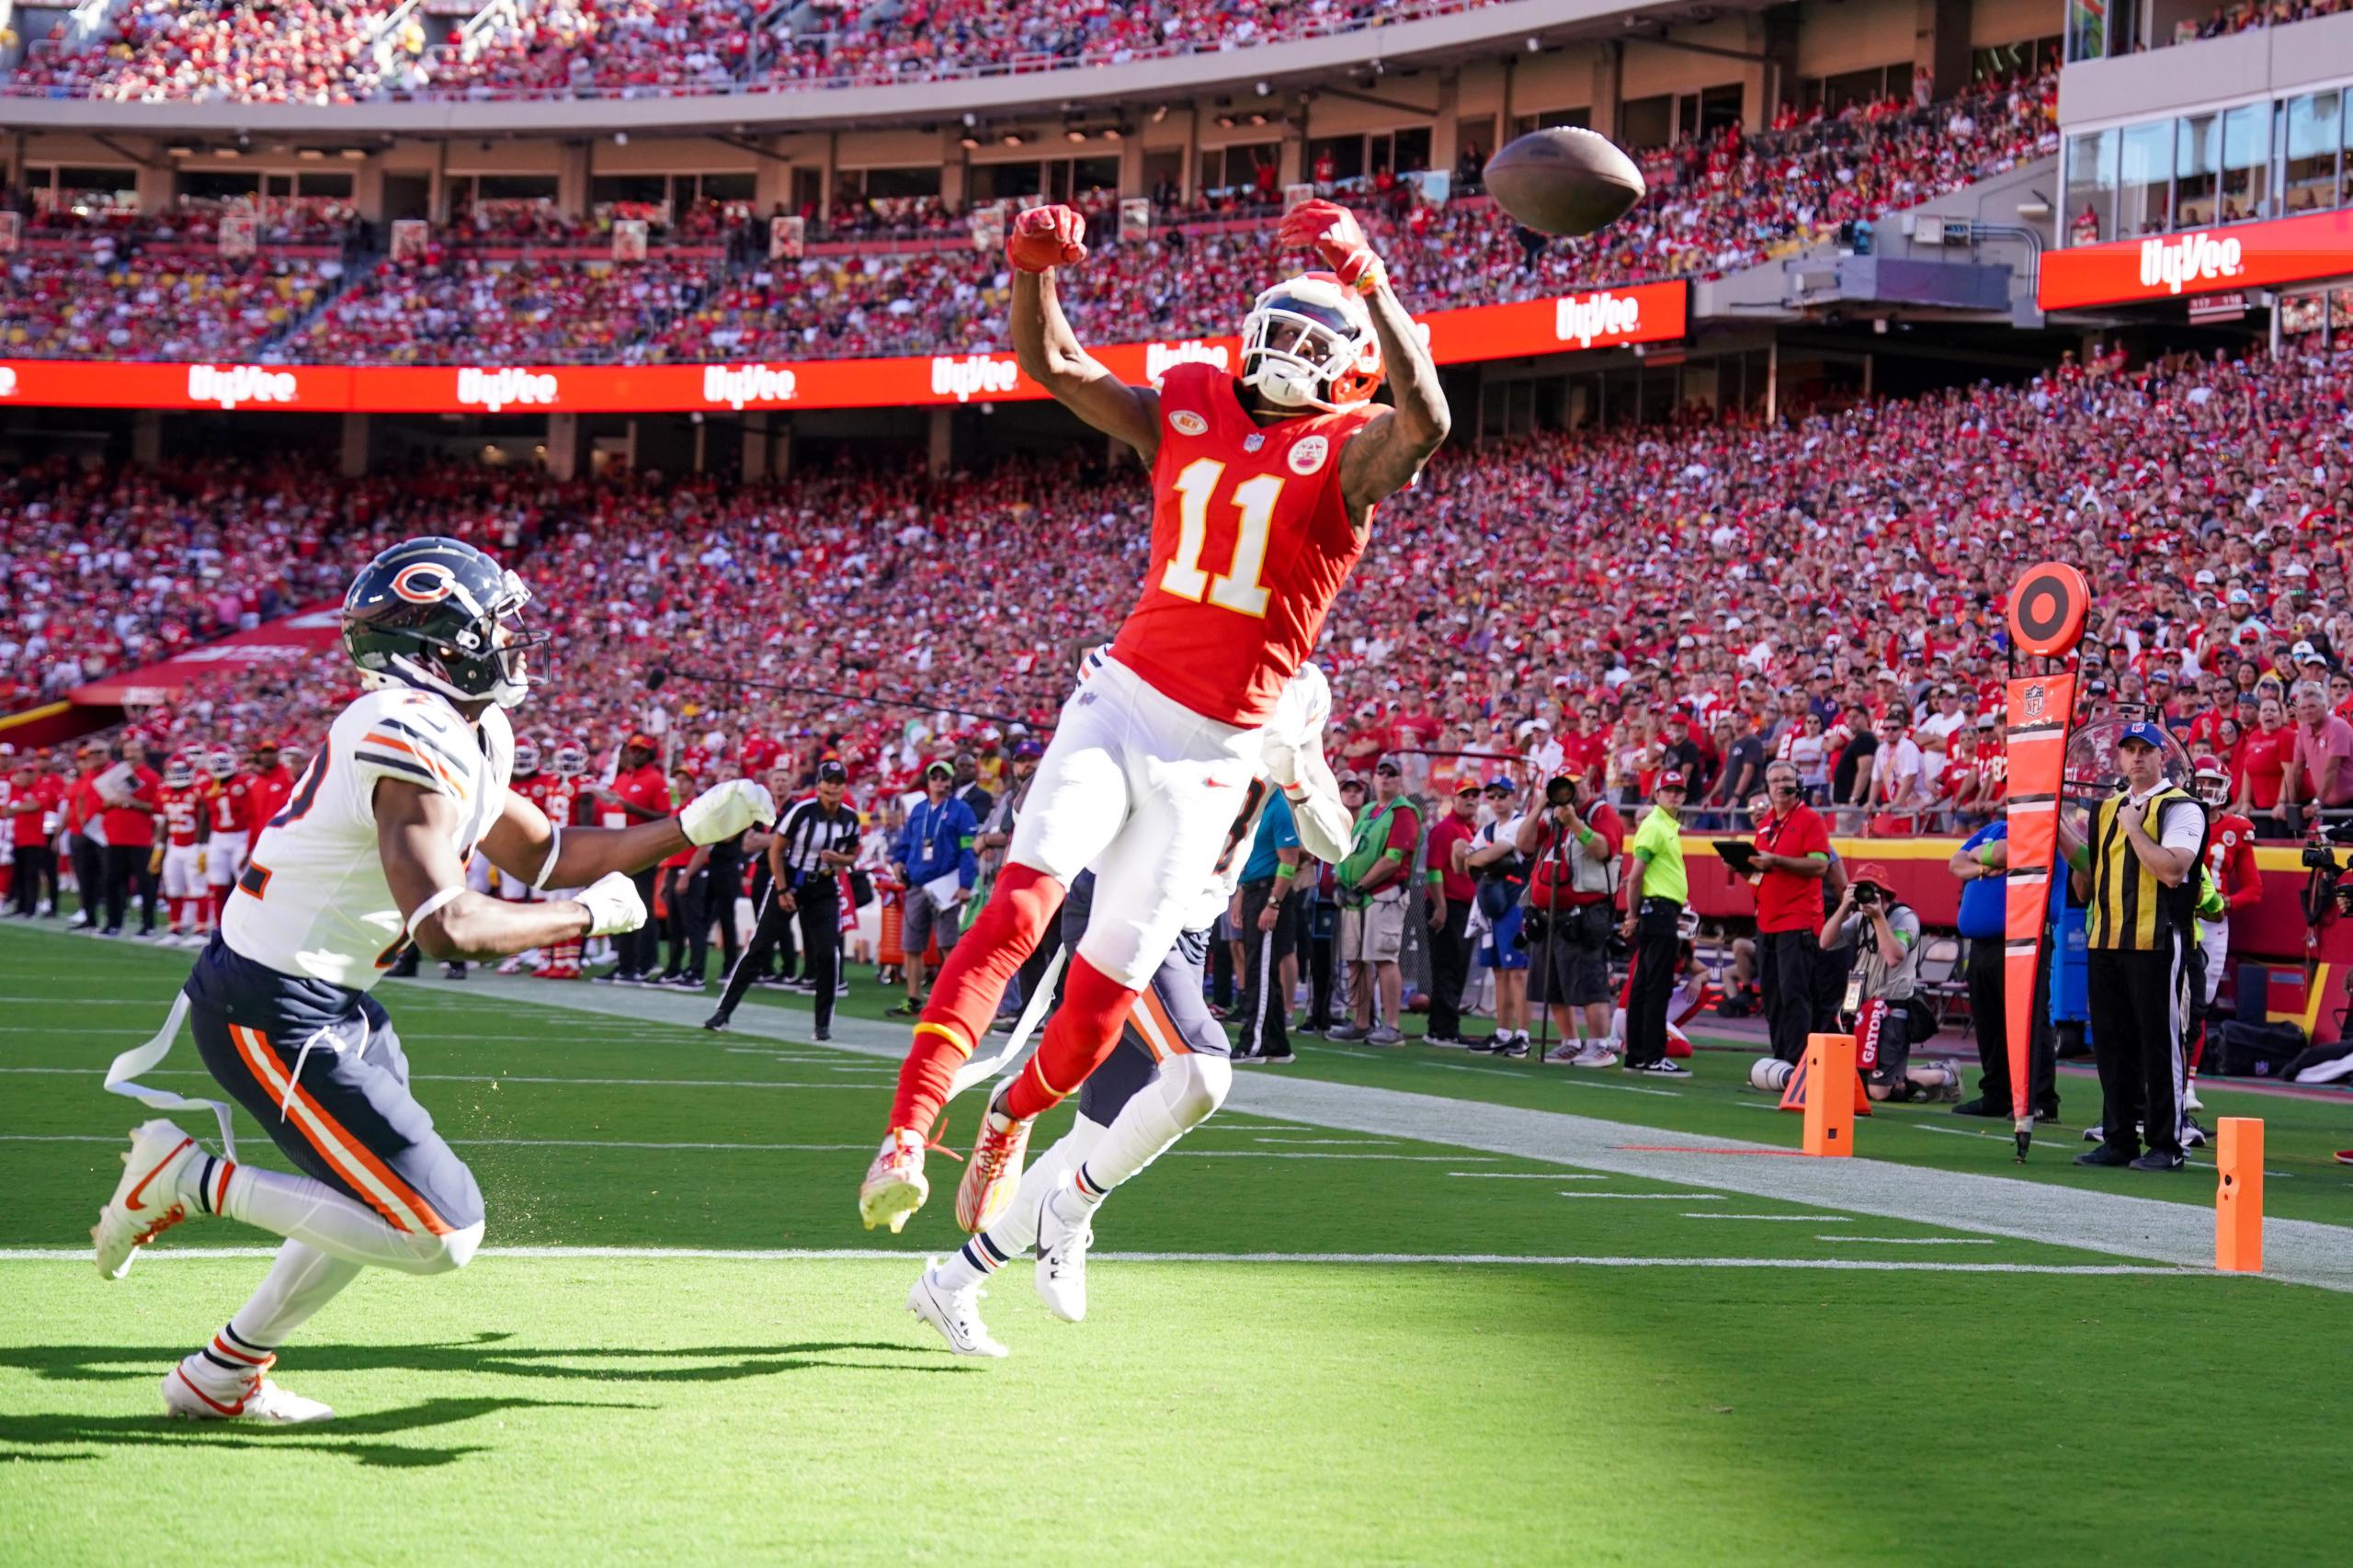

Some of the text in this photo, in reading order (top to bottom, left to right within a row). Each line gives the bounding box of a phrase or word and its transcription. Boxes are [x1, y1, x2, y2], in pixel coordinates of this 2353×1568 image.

[2140, 233, 2241, 294] HyVee
[1556, 293, 1639, 347] HyVee
[188, 364, 296, 409] HyVee
[458, 368, 557, 412] HyVee
[704, 364, 795, 409] HyVee
[931, 356, 1017, 402] HyVee
[1160, 457, 1285, 619] 11
[2027, 699, 2041, 714] NFL
